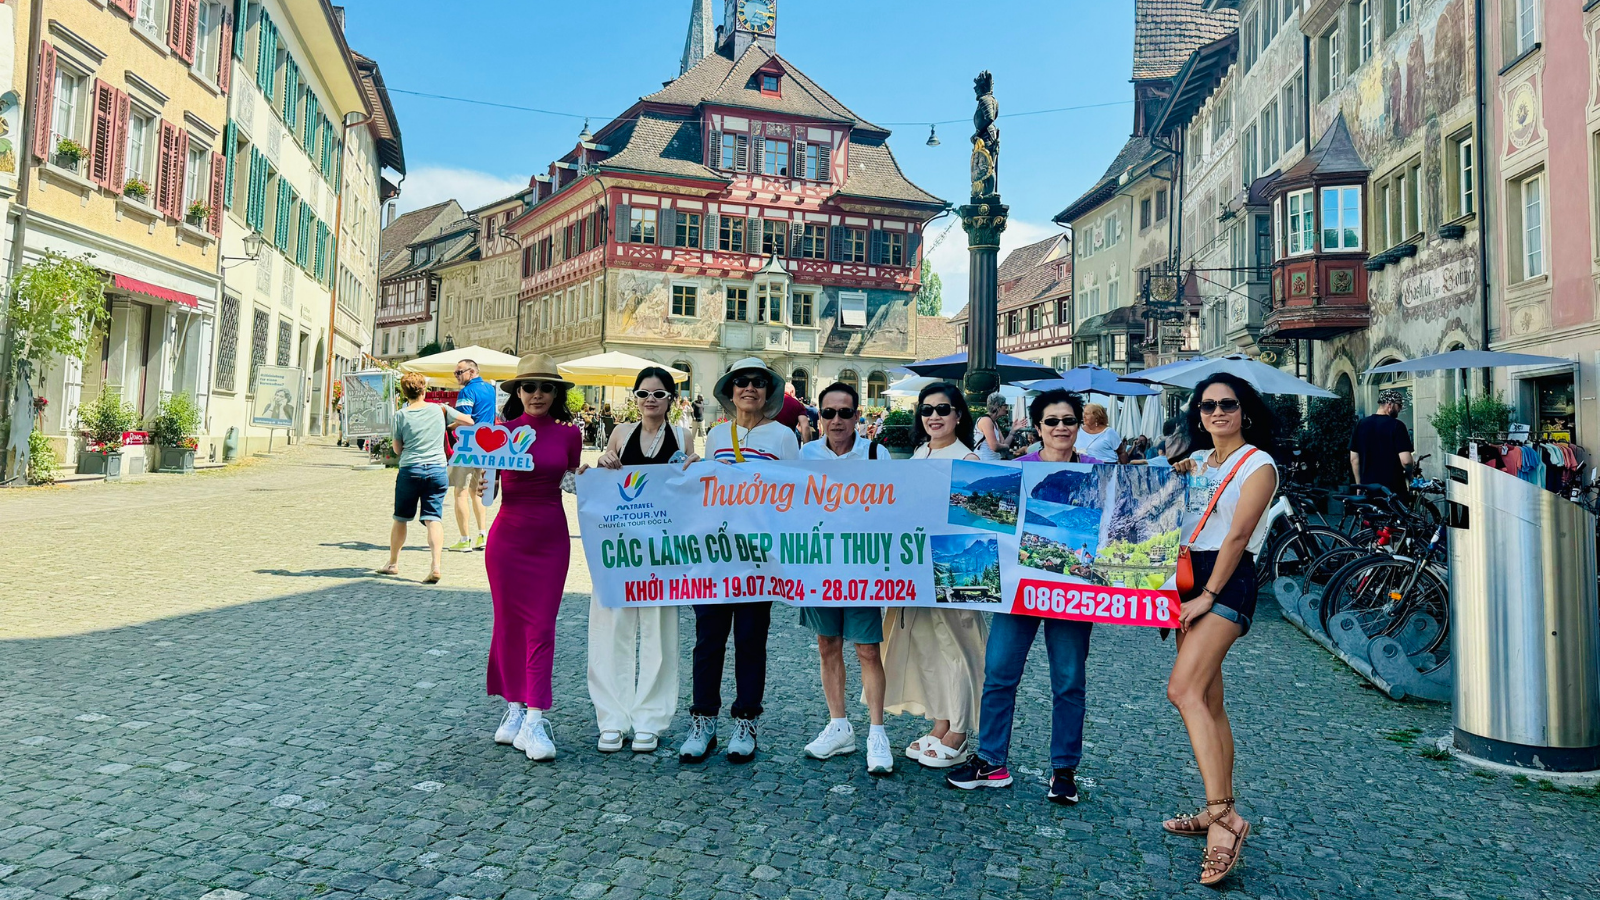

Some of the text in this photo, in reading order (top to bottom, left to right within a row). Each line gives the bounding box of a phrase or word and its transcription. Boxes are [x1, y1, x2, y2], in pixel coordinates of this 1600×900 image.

[457, 430, 475, 452] I
[700, 473, 896, 512] Thưởng Ngoạn
[603, 510, 667, 522] VIP-TOUR.VN
[601, 521, 926, 571] CÁC LÀNG CỔ ĐẸP NHẤT THUỴ SỸ
[625, 573, 664, 602] KHỞI
[669, 574, 718, 600] HÀNH:
[722, 575, 805, 601] 19.07.2024
[822, 579, 916, 601] 28.07.2024
[1023, 585, 1170, 621] 0862528118
